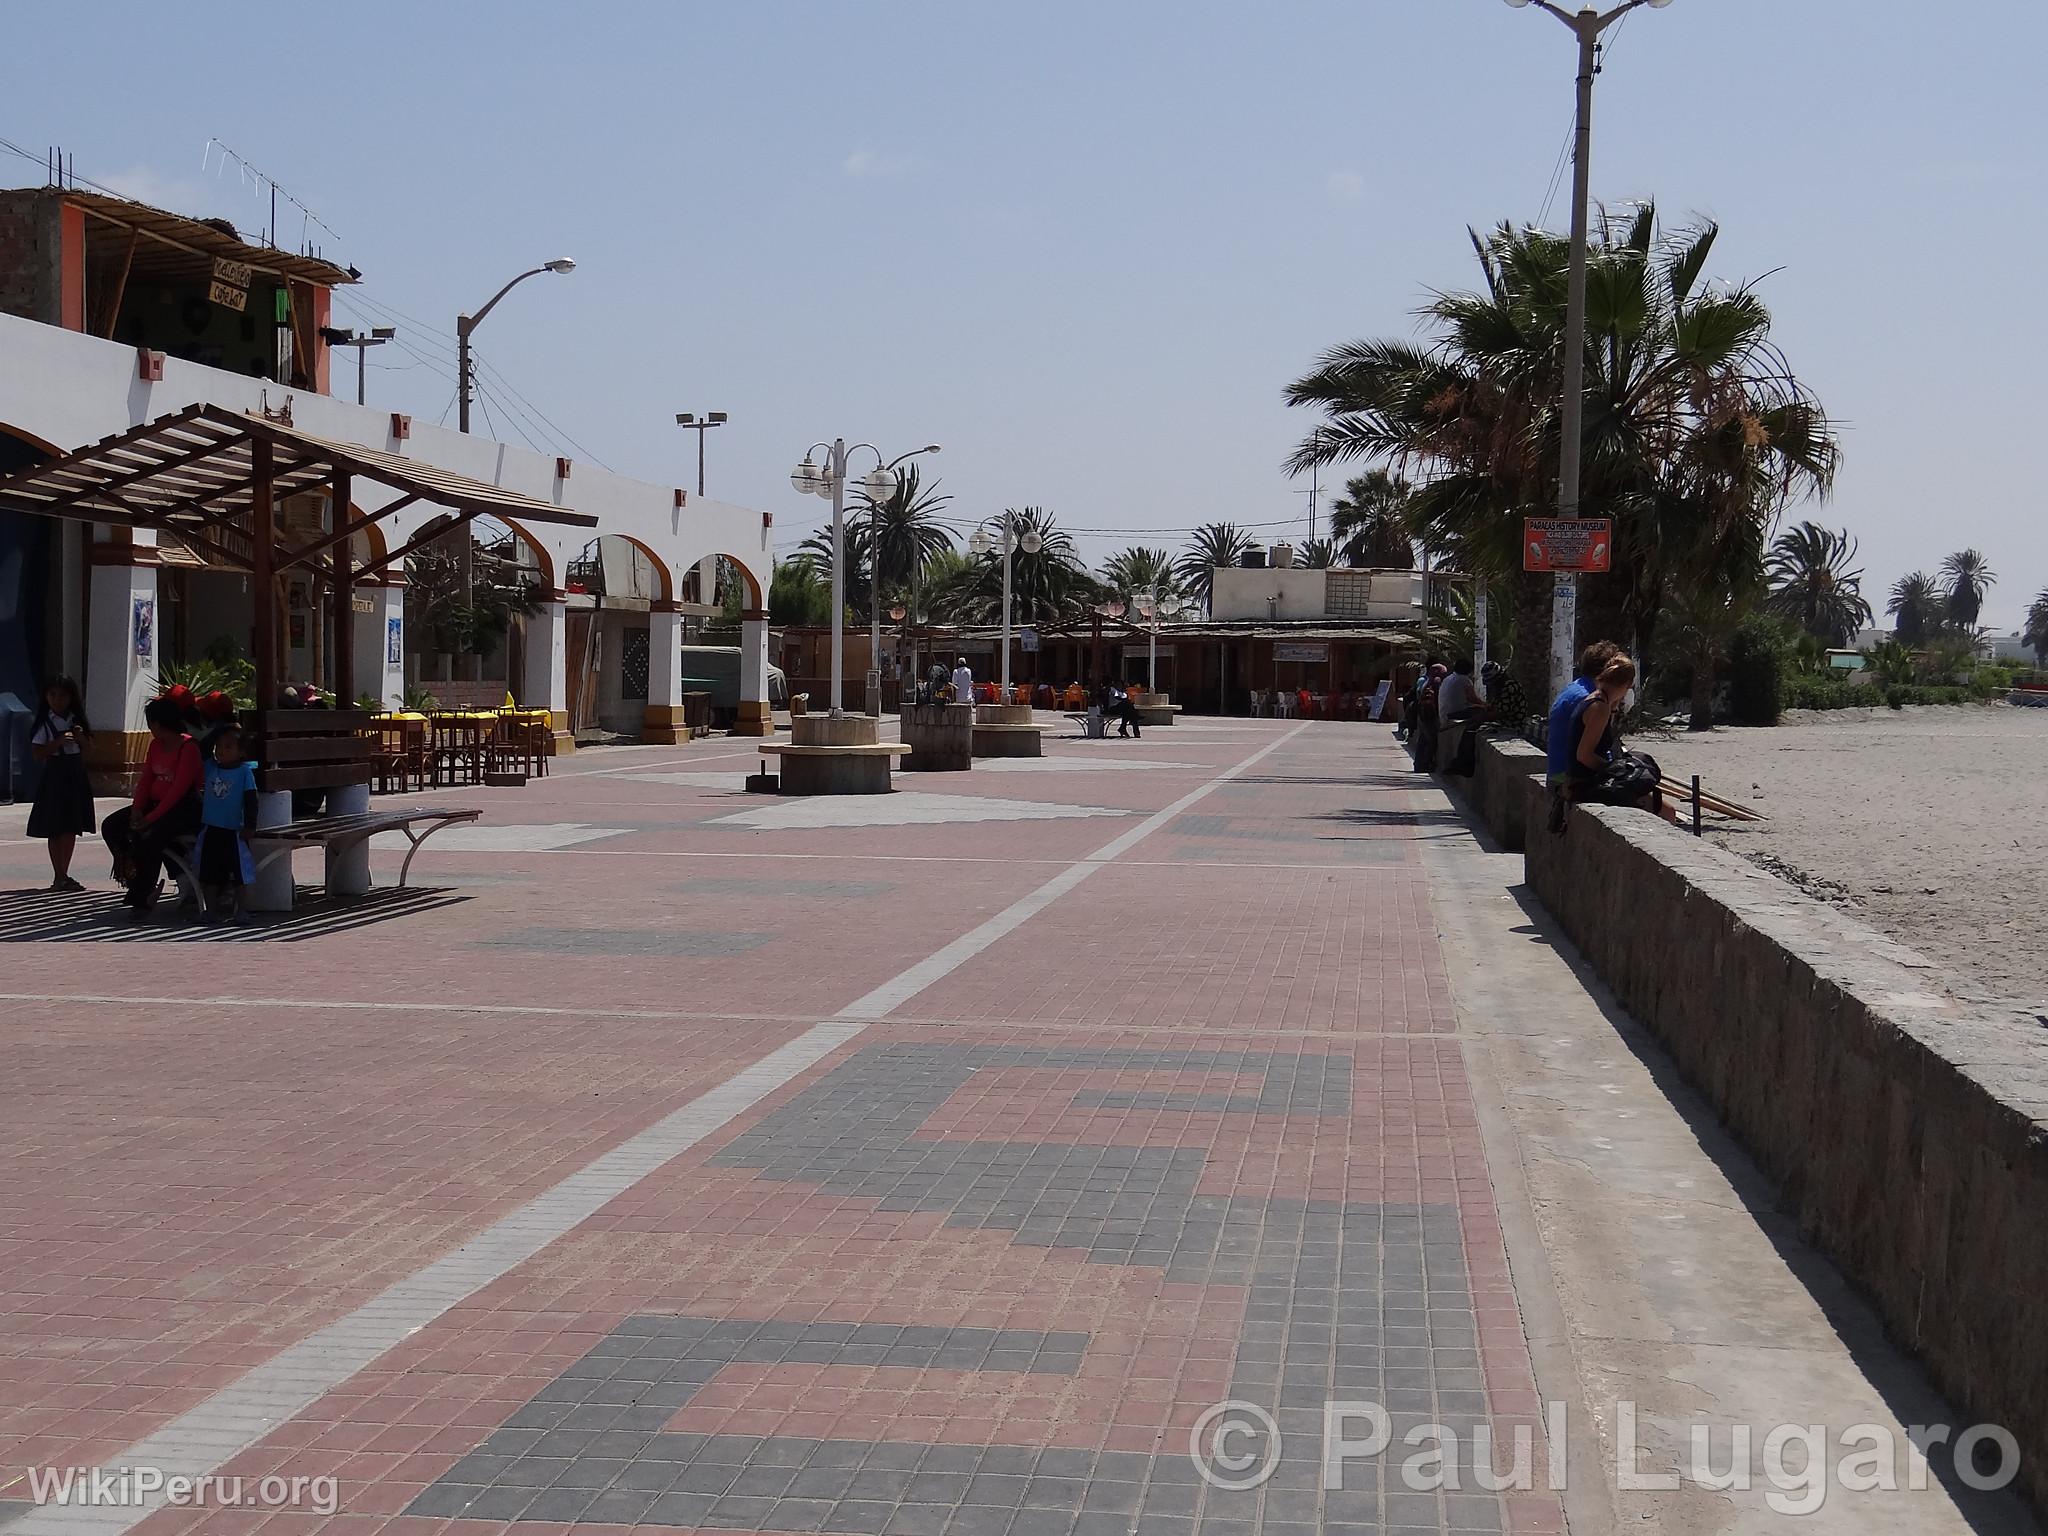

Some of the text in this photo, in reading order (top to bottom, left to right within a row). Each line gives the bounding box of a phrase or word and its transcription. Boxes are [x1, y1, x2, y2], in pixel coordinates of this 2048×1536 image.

[1529, 520, 1606, 531] PARACAS HISTORY MUSEUM
